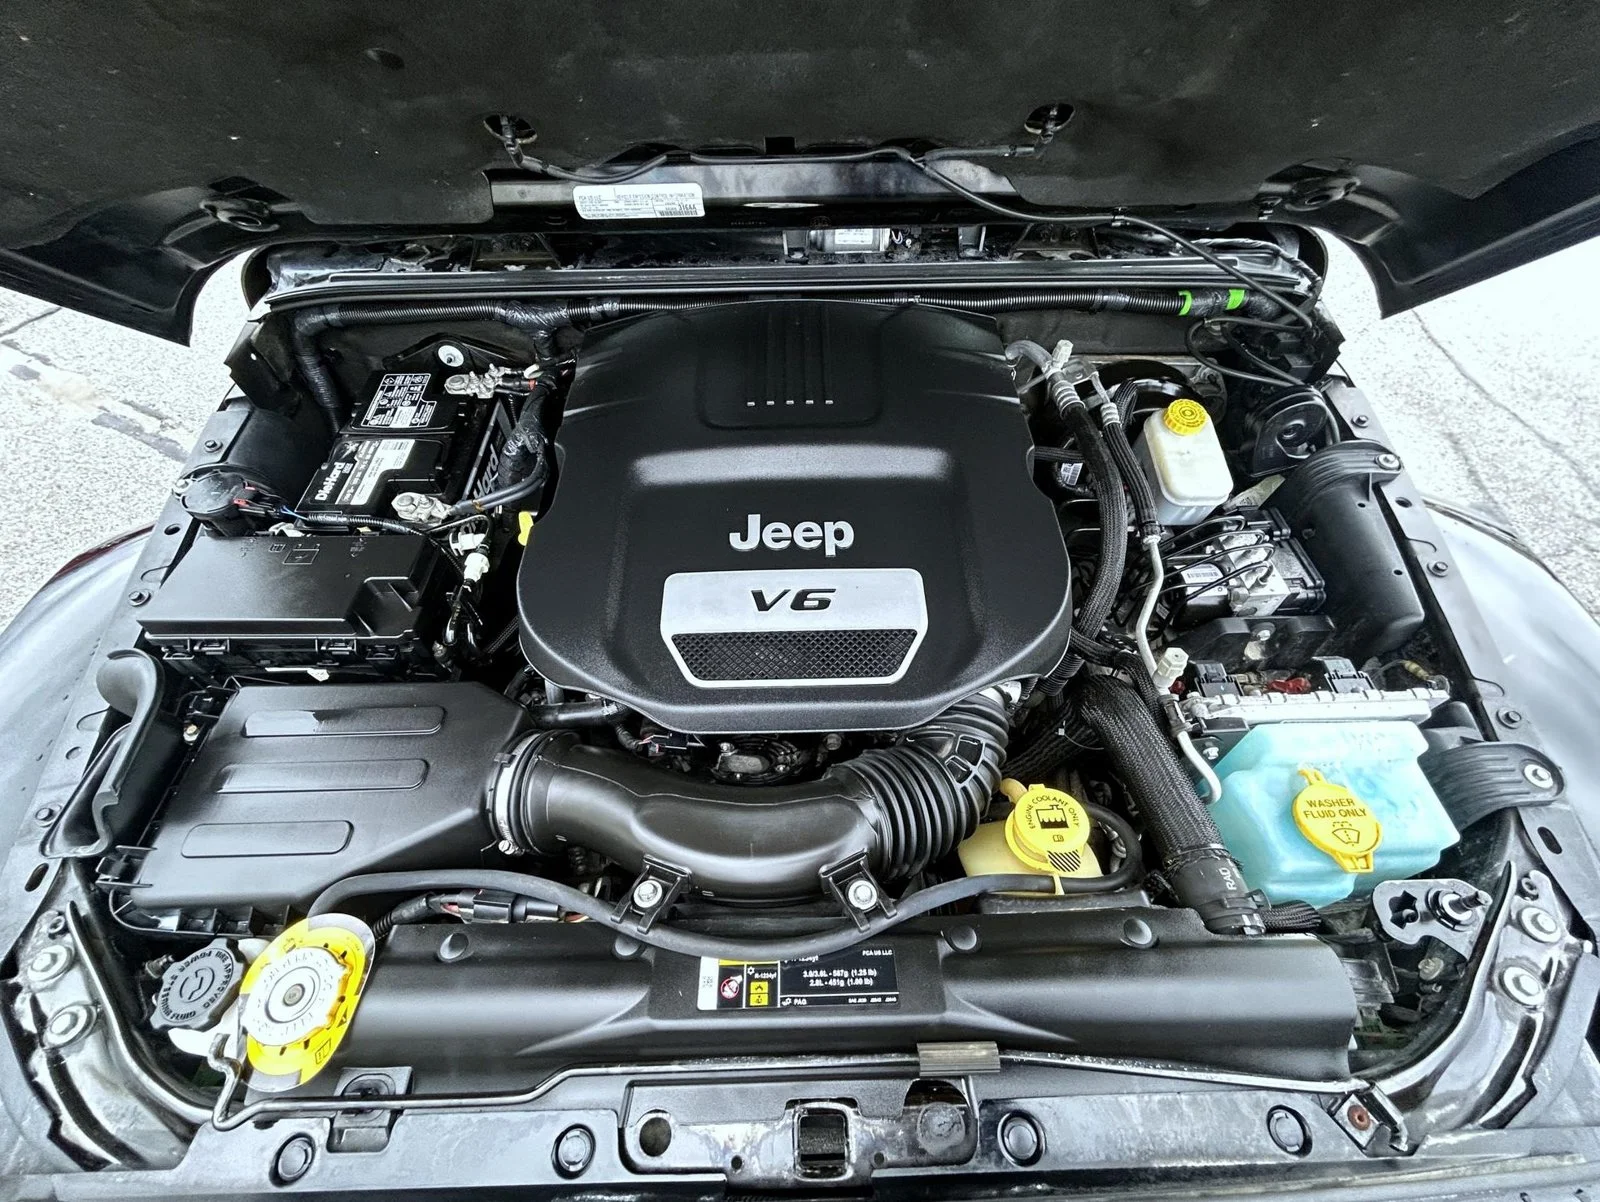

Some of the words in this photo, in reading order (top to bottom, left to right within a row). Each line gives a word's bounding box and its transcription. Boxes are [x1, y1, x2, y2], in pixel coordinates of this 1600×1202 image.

[314, 462, 346, 501] DieHard
[729, 513, 855, 557] Jeep
[750, 588, 837, 612] V6
[1025, 804, 1036, 829] ENGINE
[1032, 795, 1069, 807] COOLANT
[1068, 807, 1080, 828] ONLY
[1303, 810, 1336, 819] FLUID
[1338, 808, 1367, 818] ONLY
[1306, 798, 1356, 808] WASHER
[1219, 867, 1238, 890] RAD
[179, 950, 212, 972] POWER
[170, 1010, 196, 1020] FLUID
